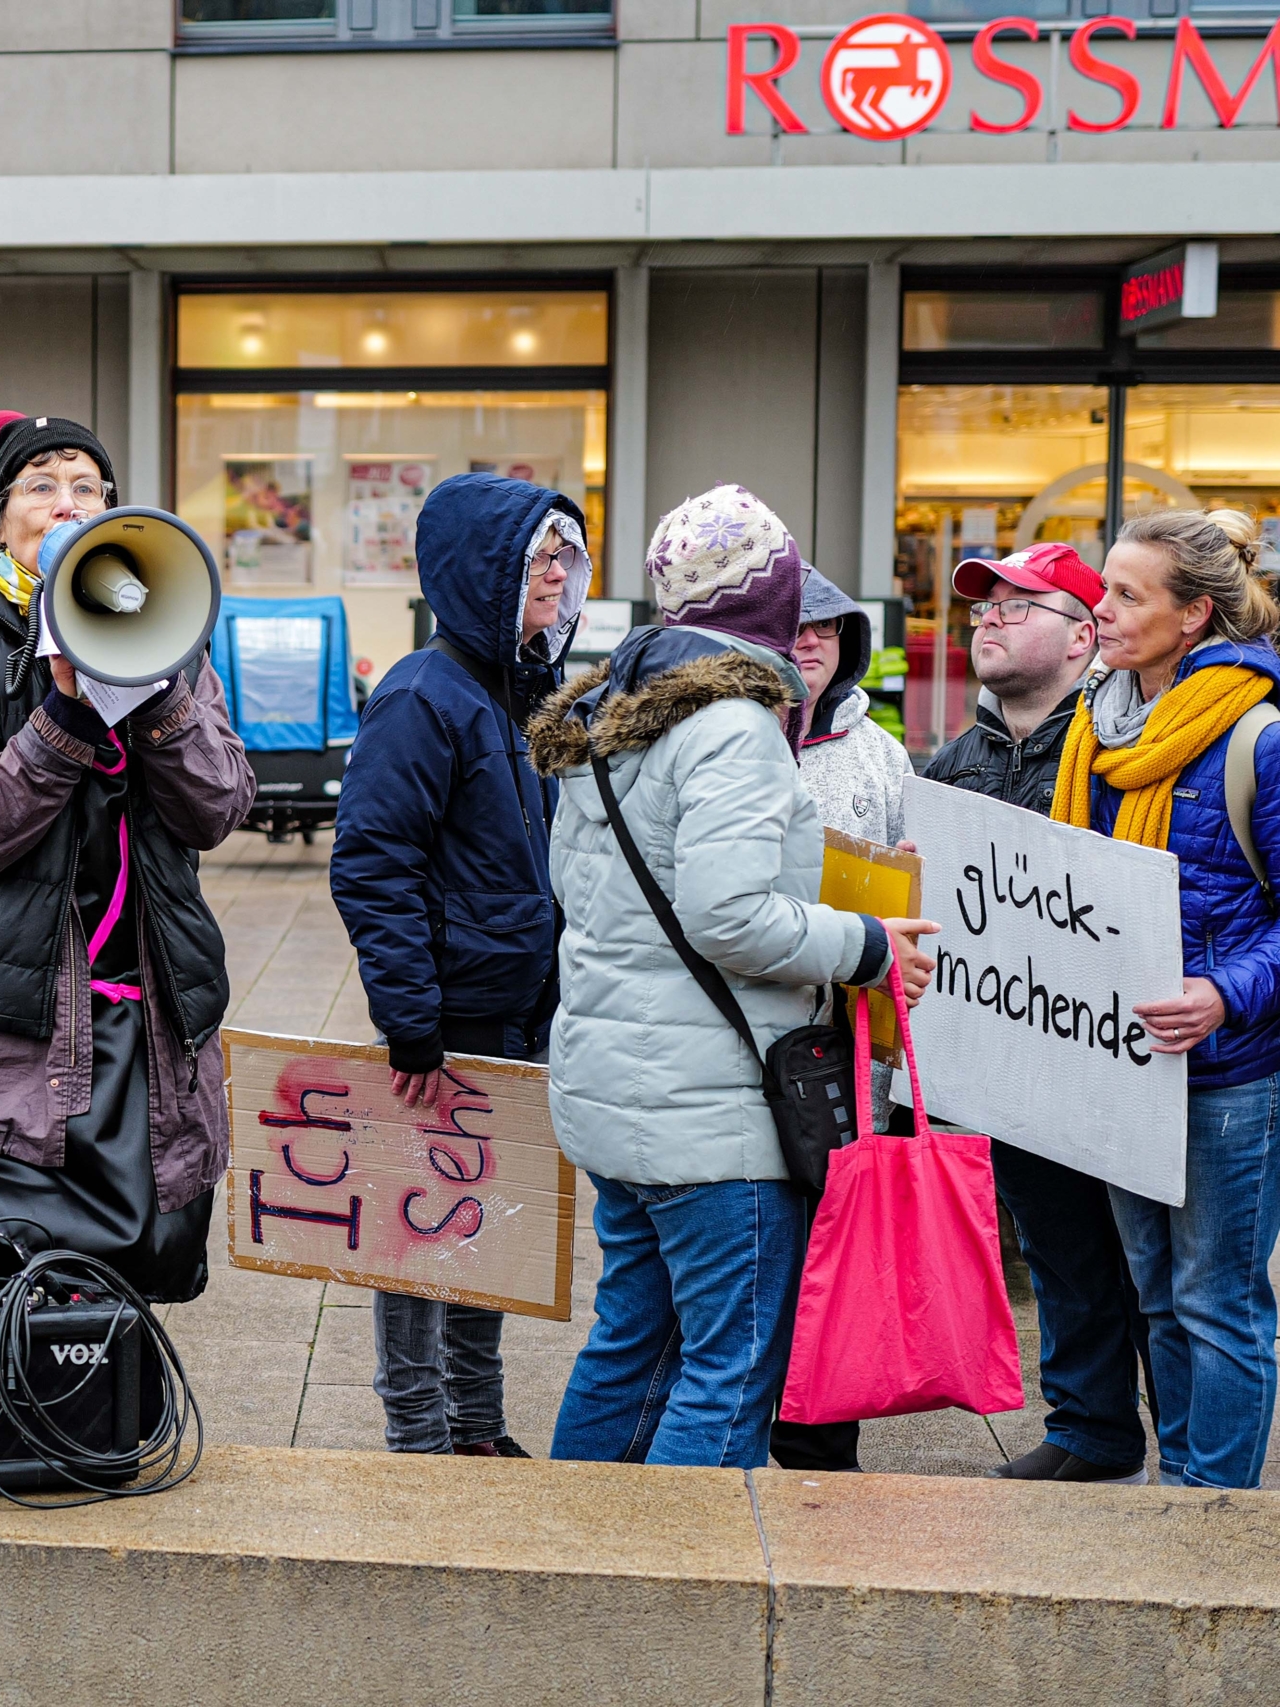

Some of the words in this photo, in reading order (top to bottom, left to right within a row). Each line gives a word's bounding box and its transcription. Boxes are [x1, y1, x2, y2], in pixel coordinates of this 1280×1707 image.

[956, 842, 1121, 943] glück-
[935, 945, 1153, 1067] machende
[249, 1085, 363, 1251] Ich
[49, 1343, 110, 1366] VOX
